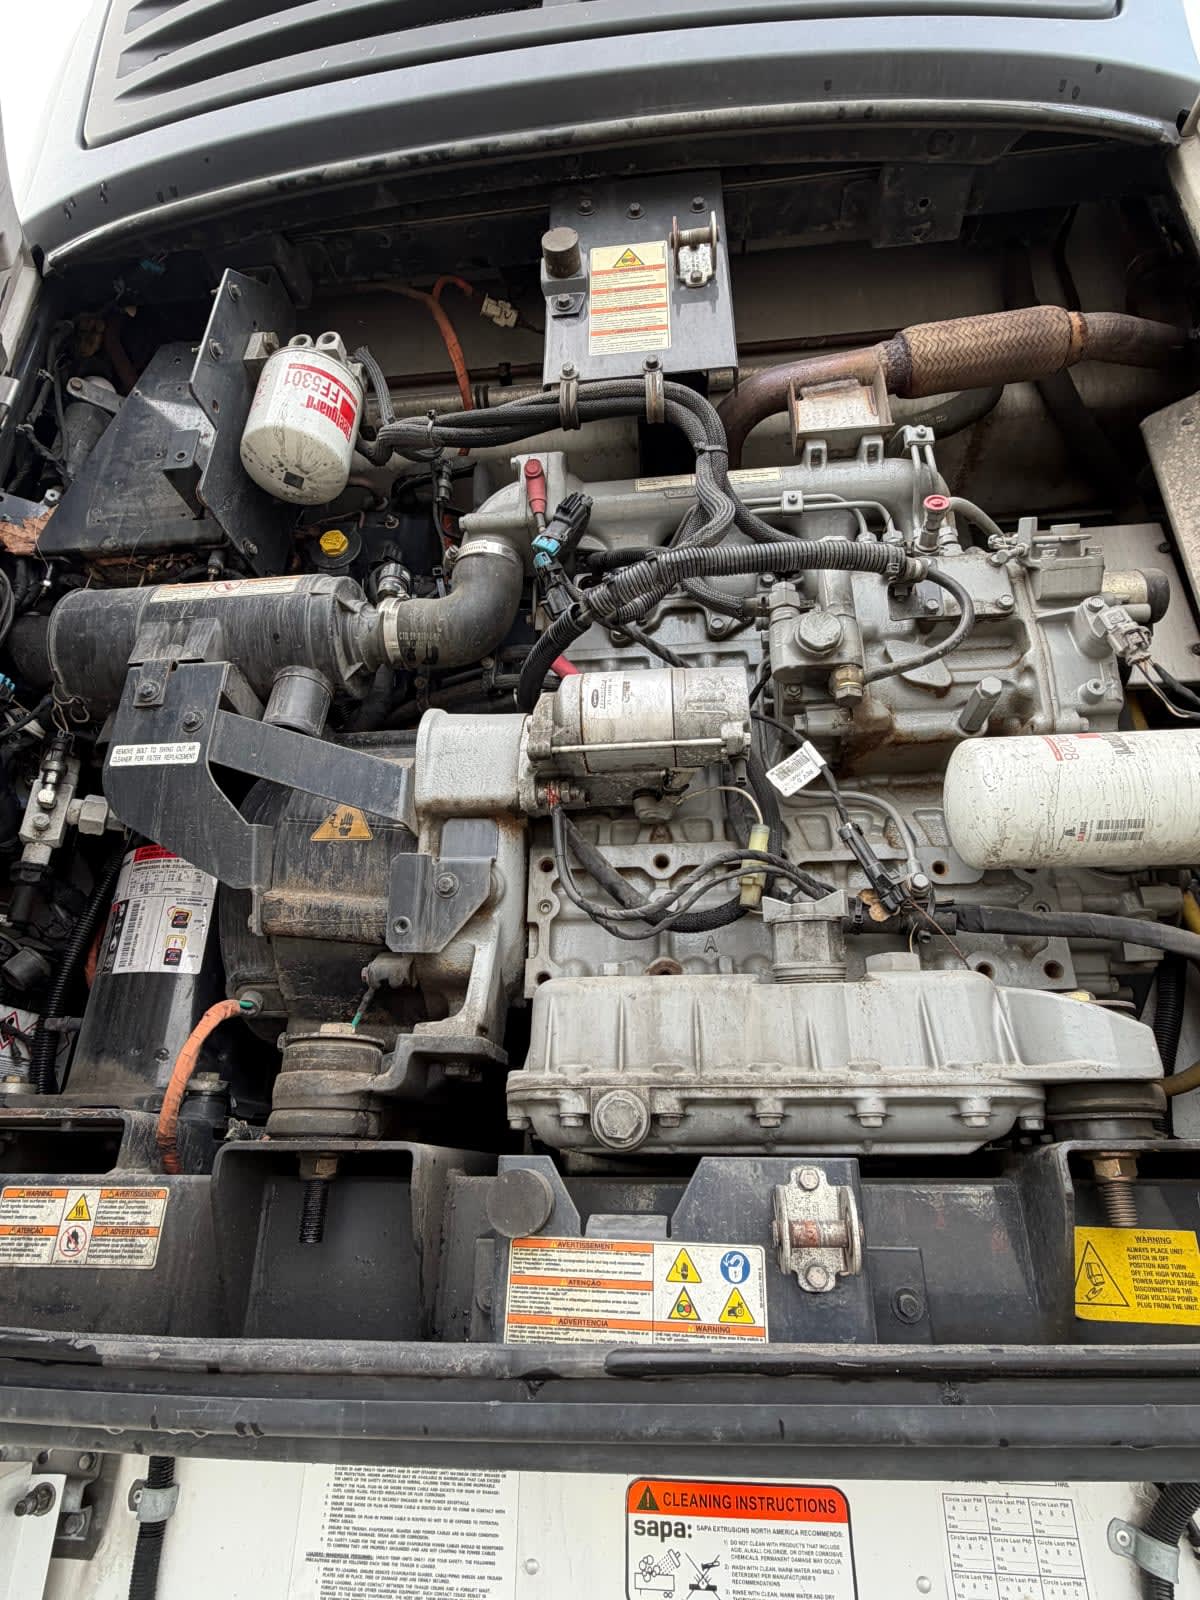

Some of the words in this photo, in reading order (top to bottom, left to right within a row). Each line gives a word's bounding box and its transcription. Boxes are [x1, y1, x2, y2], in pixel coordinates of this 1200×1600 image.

[284, 370, 341, 404] FF5301
[704, 935, 718, 953] A
[1135, 1236, 1172, 1244] WARNING
[557, 1241, 615, 1250] AVERTISSEMENT
[1134, 1286, 1180, 1294] DISCONNECTING
[1150, 1294, 1177, 1302] VOLTAGE
[558, 1318, 609, 1327] ADVERTENCIA
[695, 1325, 731, 1334] WARNING
[663, 1492, 732, 1509] CLEANING
[735, 1495, 837, 1514] INSTRUCTIONS
[633, 1519, 692, 1543] sapa:
[696, 1524, 712, 1532] SAPA
[712, 1525, 750, 1533] EXTRUSIONS
[750, 1527, 772, 1535] NORTH
[772, 1528, 799, 1536] AMERICA
[772, 1573, 816, 1582] MANUFACTURER'S
[732, 1588, 749, 1596] RINSE
